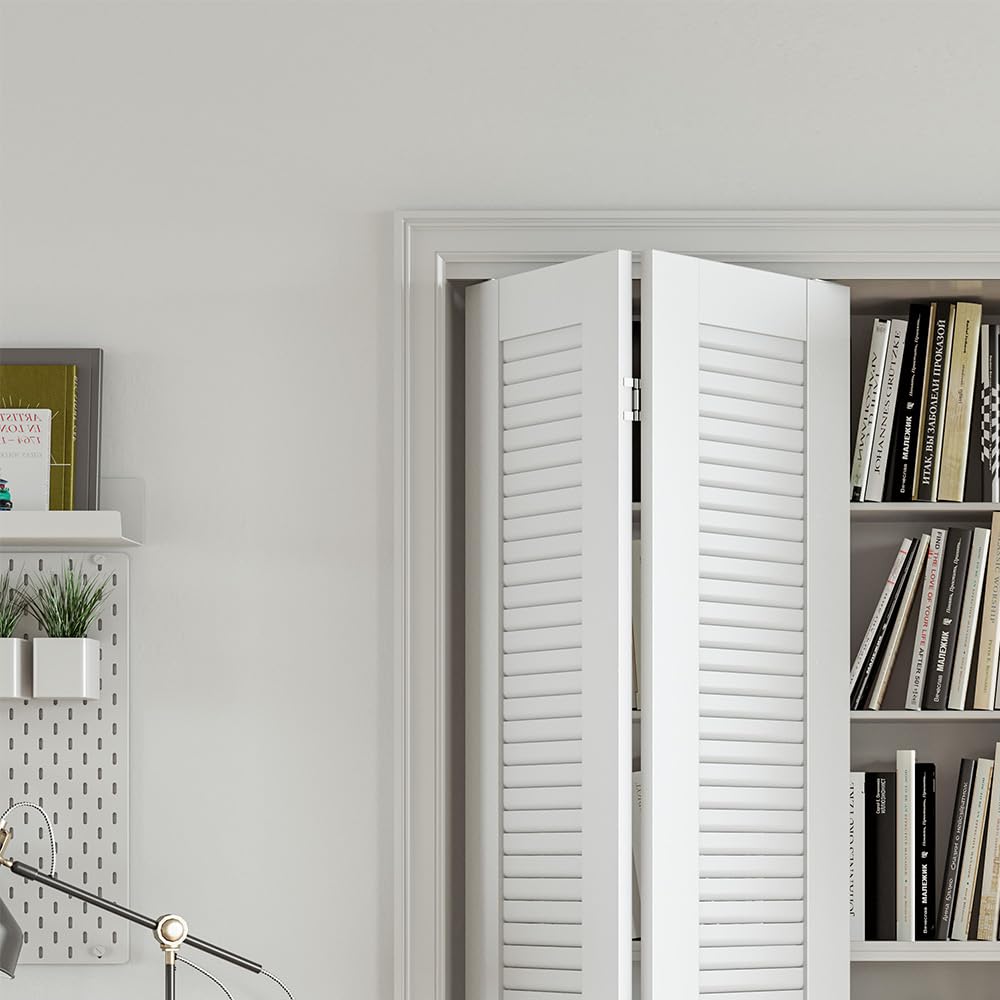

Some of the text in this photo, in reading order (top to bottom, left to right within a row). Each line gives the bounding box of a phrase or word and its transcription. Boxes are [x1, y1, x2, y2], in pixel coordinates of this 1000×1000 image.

[922, 319, 945, 485] ИТАК, ВЫ ЗАБОЛЕЛИ ПРОКАЗОЙ
[874, 399, 890, 474] JOHANNES
[902, 415, 912, 460] МАЛЕЖИК
[934, 531, 942, 550] FIND
[929, 569, 937, 590] LOVE
[927, 592, 934, 604] OF
[990, 576, 1000, 624] WORSHIP
[922, 605, 932, 628] YOUR
[920, 629, 929, 646] LIFE
[937, 630, 949, 672] МАЛЕЖИК
[916, 648, 925, 674] AFTER
[942, 903, 950, 921] Анна
[950, 842, 959, 870] Сказки
